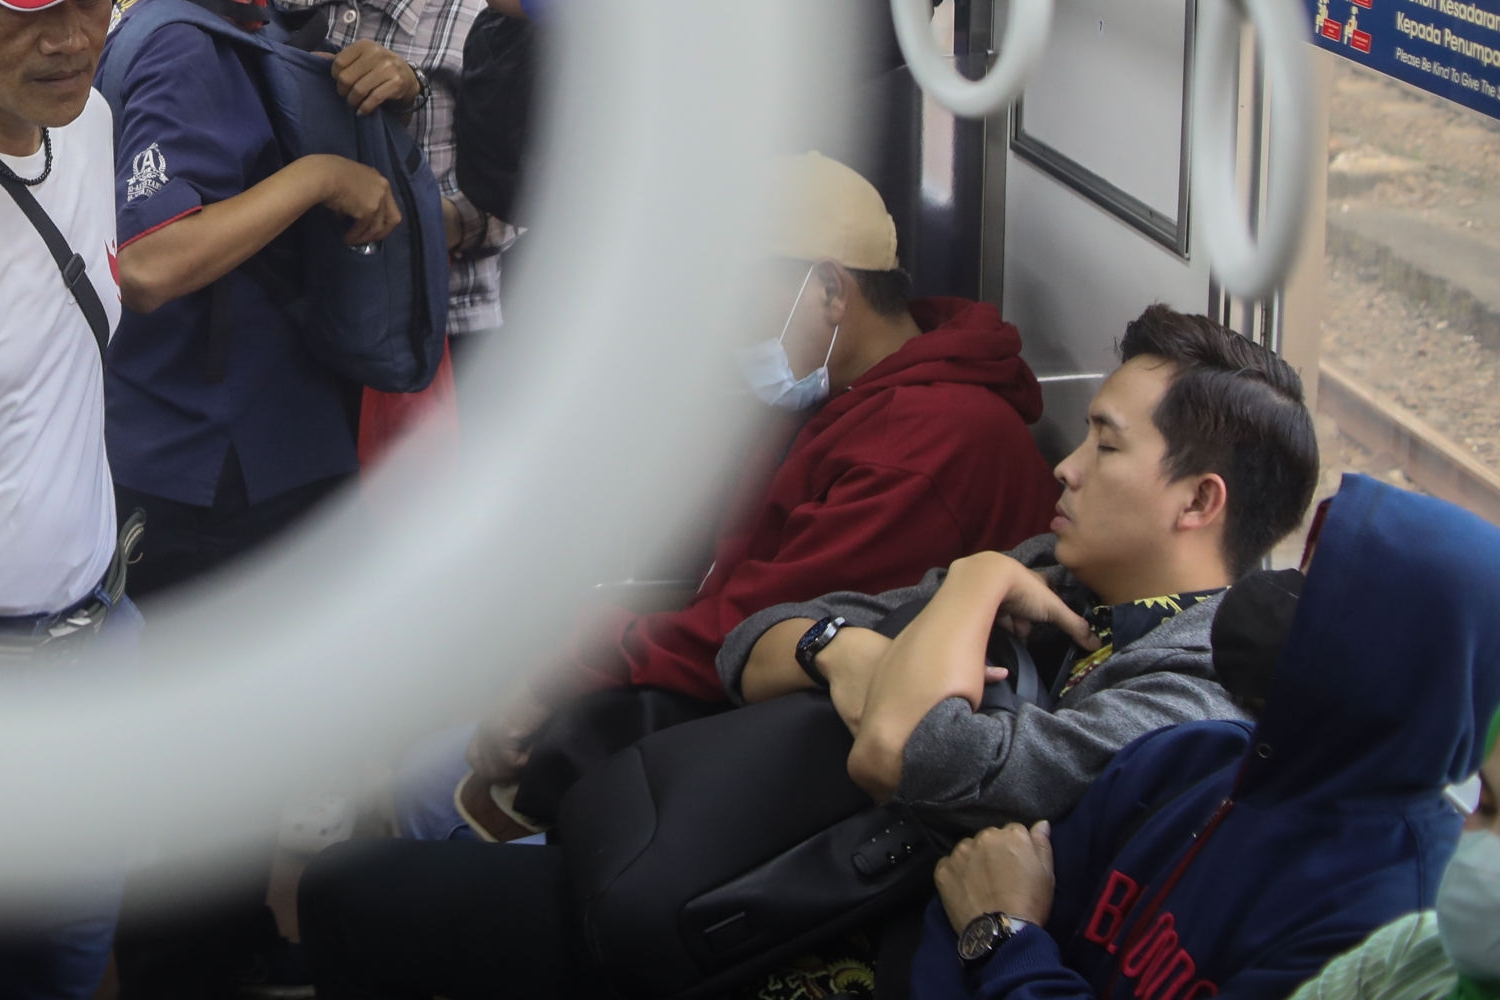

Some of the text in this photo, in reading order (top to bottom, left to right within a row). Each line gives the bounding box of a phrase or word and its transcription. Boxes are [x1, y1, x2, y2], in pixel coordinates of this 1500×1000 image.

[1396, 11, 1441, 45] Kepada
[1395, 47, 1420, 68] Please
[1421, 57, 1431, 72] Be
[1432, 61, 1450, 80] Kind
[1451, 67, 1460, 83] To
[1461, 72, 1480, 91] Give
[1481, 79, 1496, 97] The
